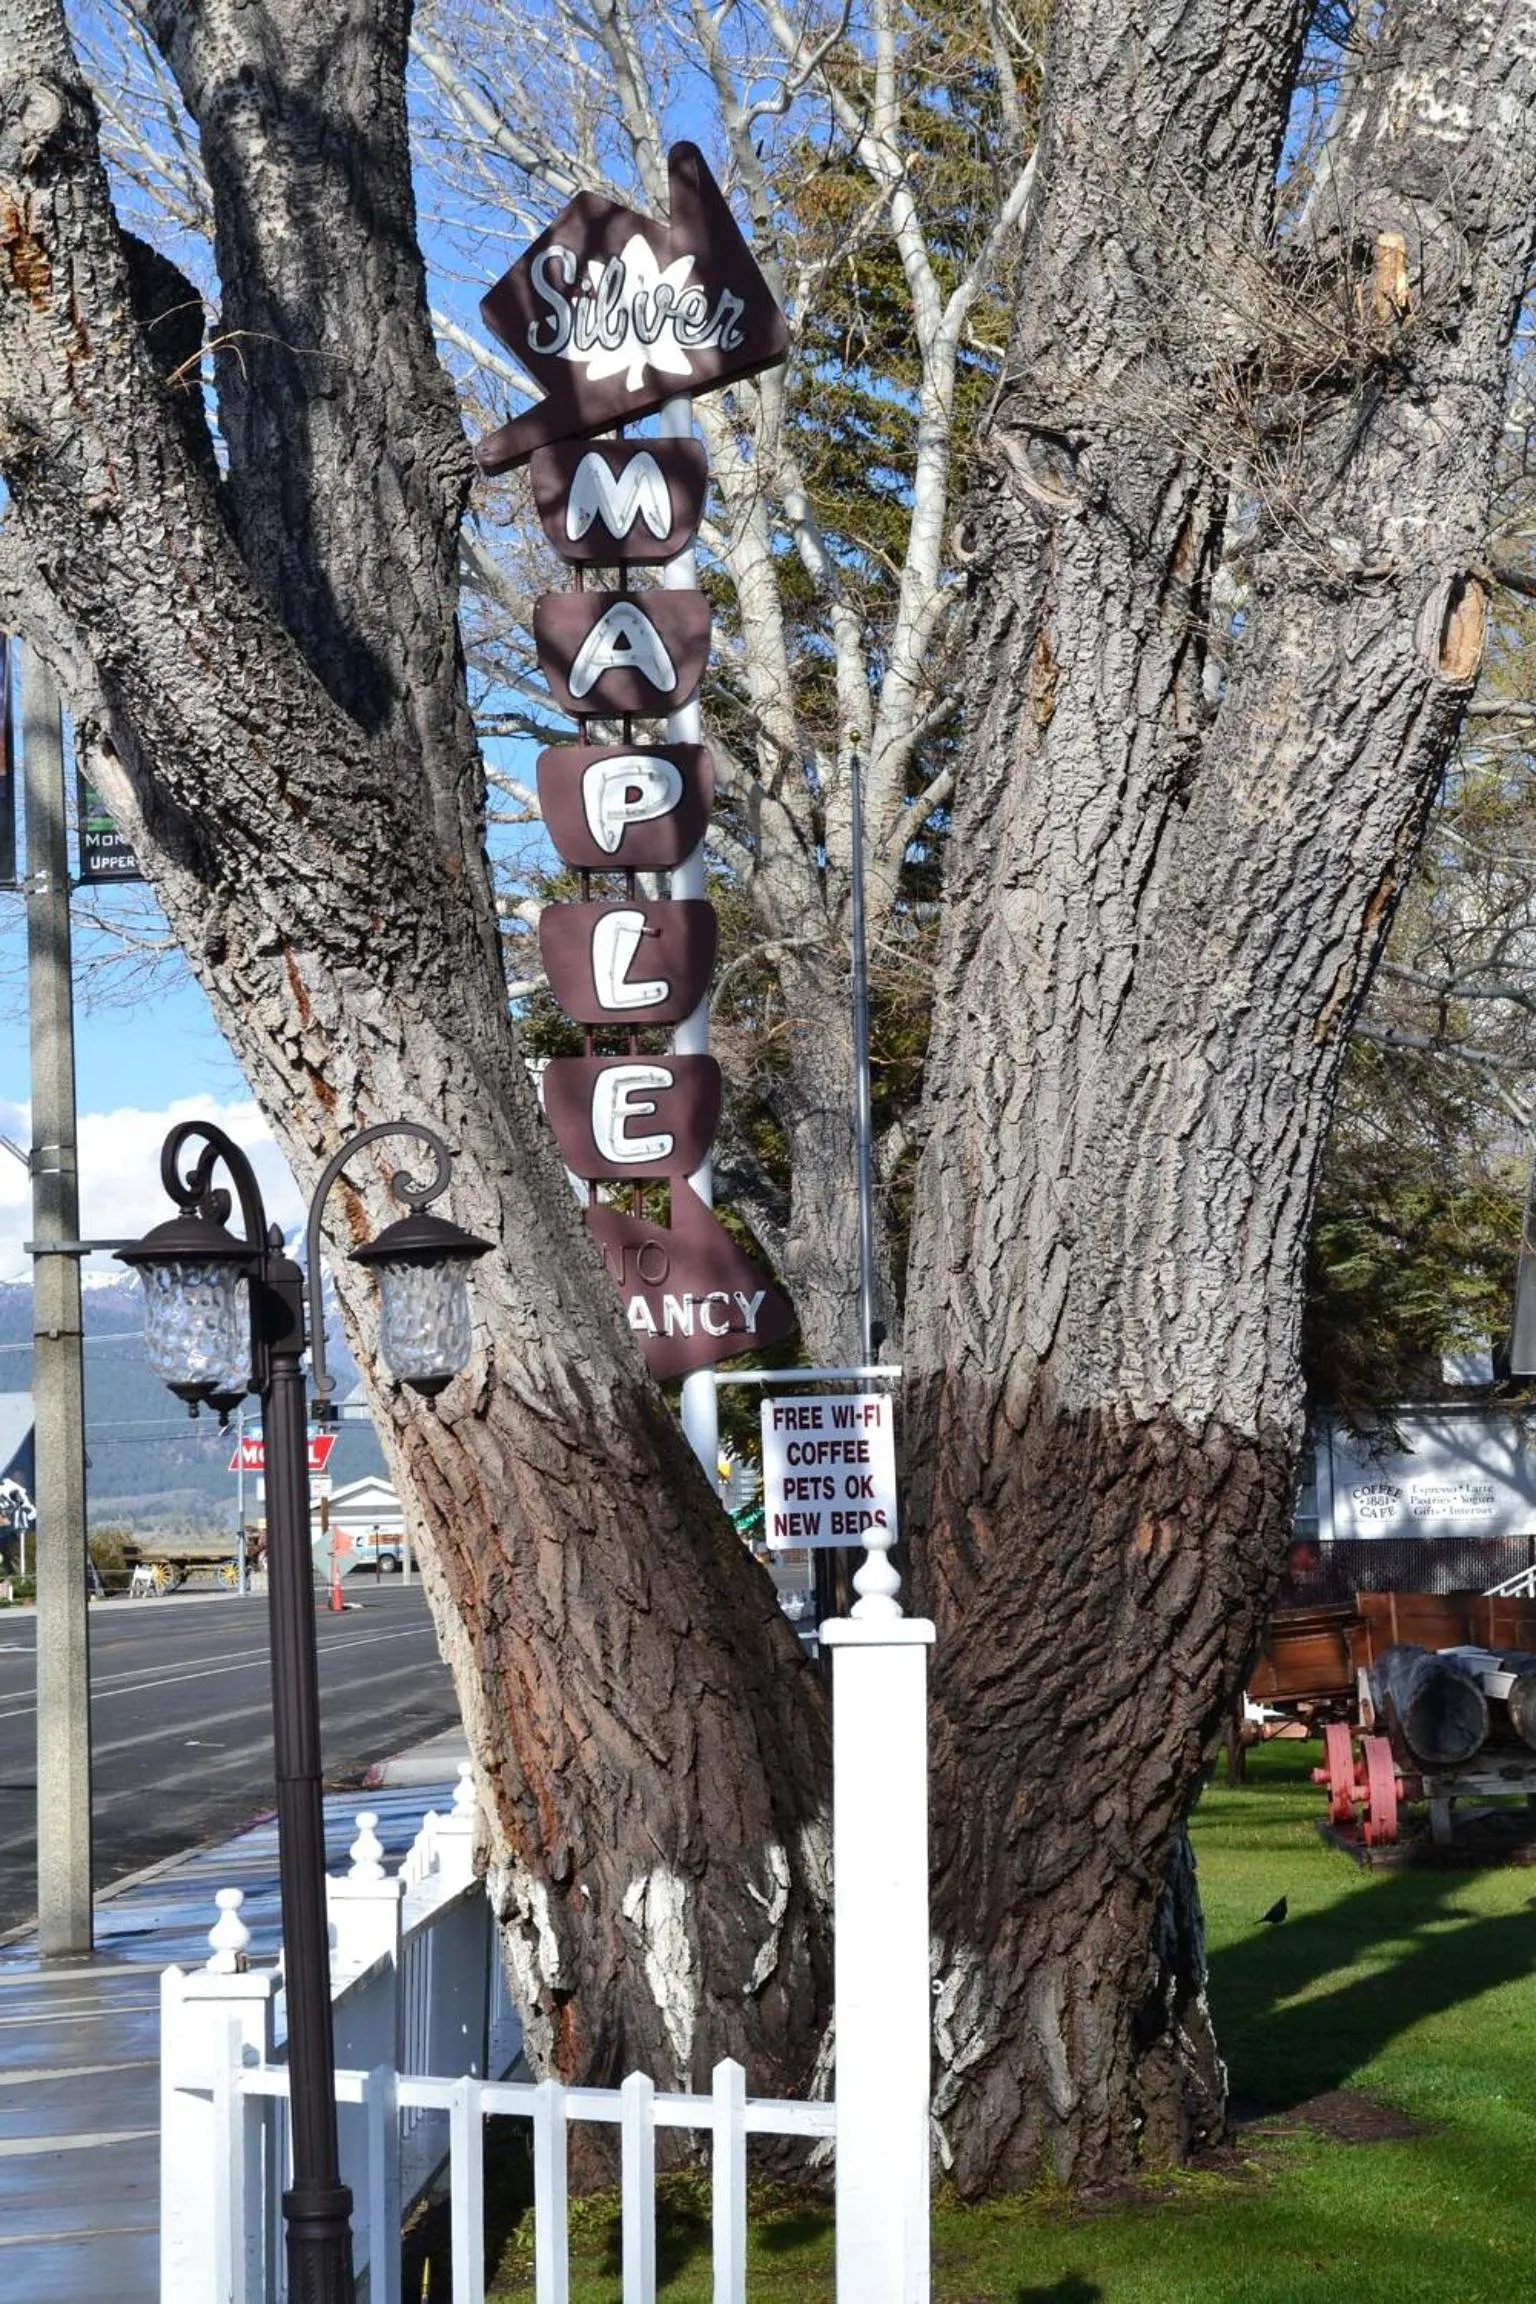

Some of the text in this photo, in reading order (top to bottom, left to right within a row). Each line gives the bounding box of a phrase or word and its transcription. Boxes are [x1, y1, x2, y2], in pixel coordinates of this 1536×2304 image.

[527, 244, 747, 354] Silver
[600, 1239, 670, 1286] NO
[773, 1404, 881, 1430] FREE WI-FI
[786, 1440, 870, 1466] COFFEE
[783, 1475, 874, 1501] PETS OK
[1352, 1484, 1404, 1500] COFFEE
[774, 1512, 820, 1536] NEW
[1360, 1506, 1397, 1518] CAFE
